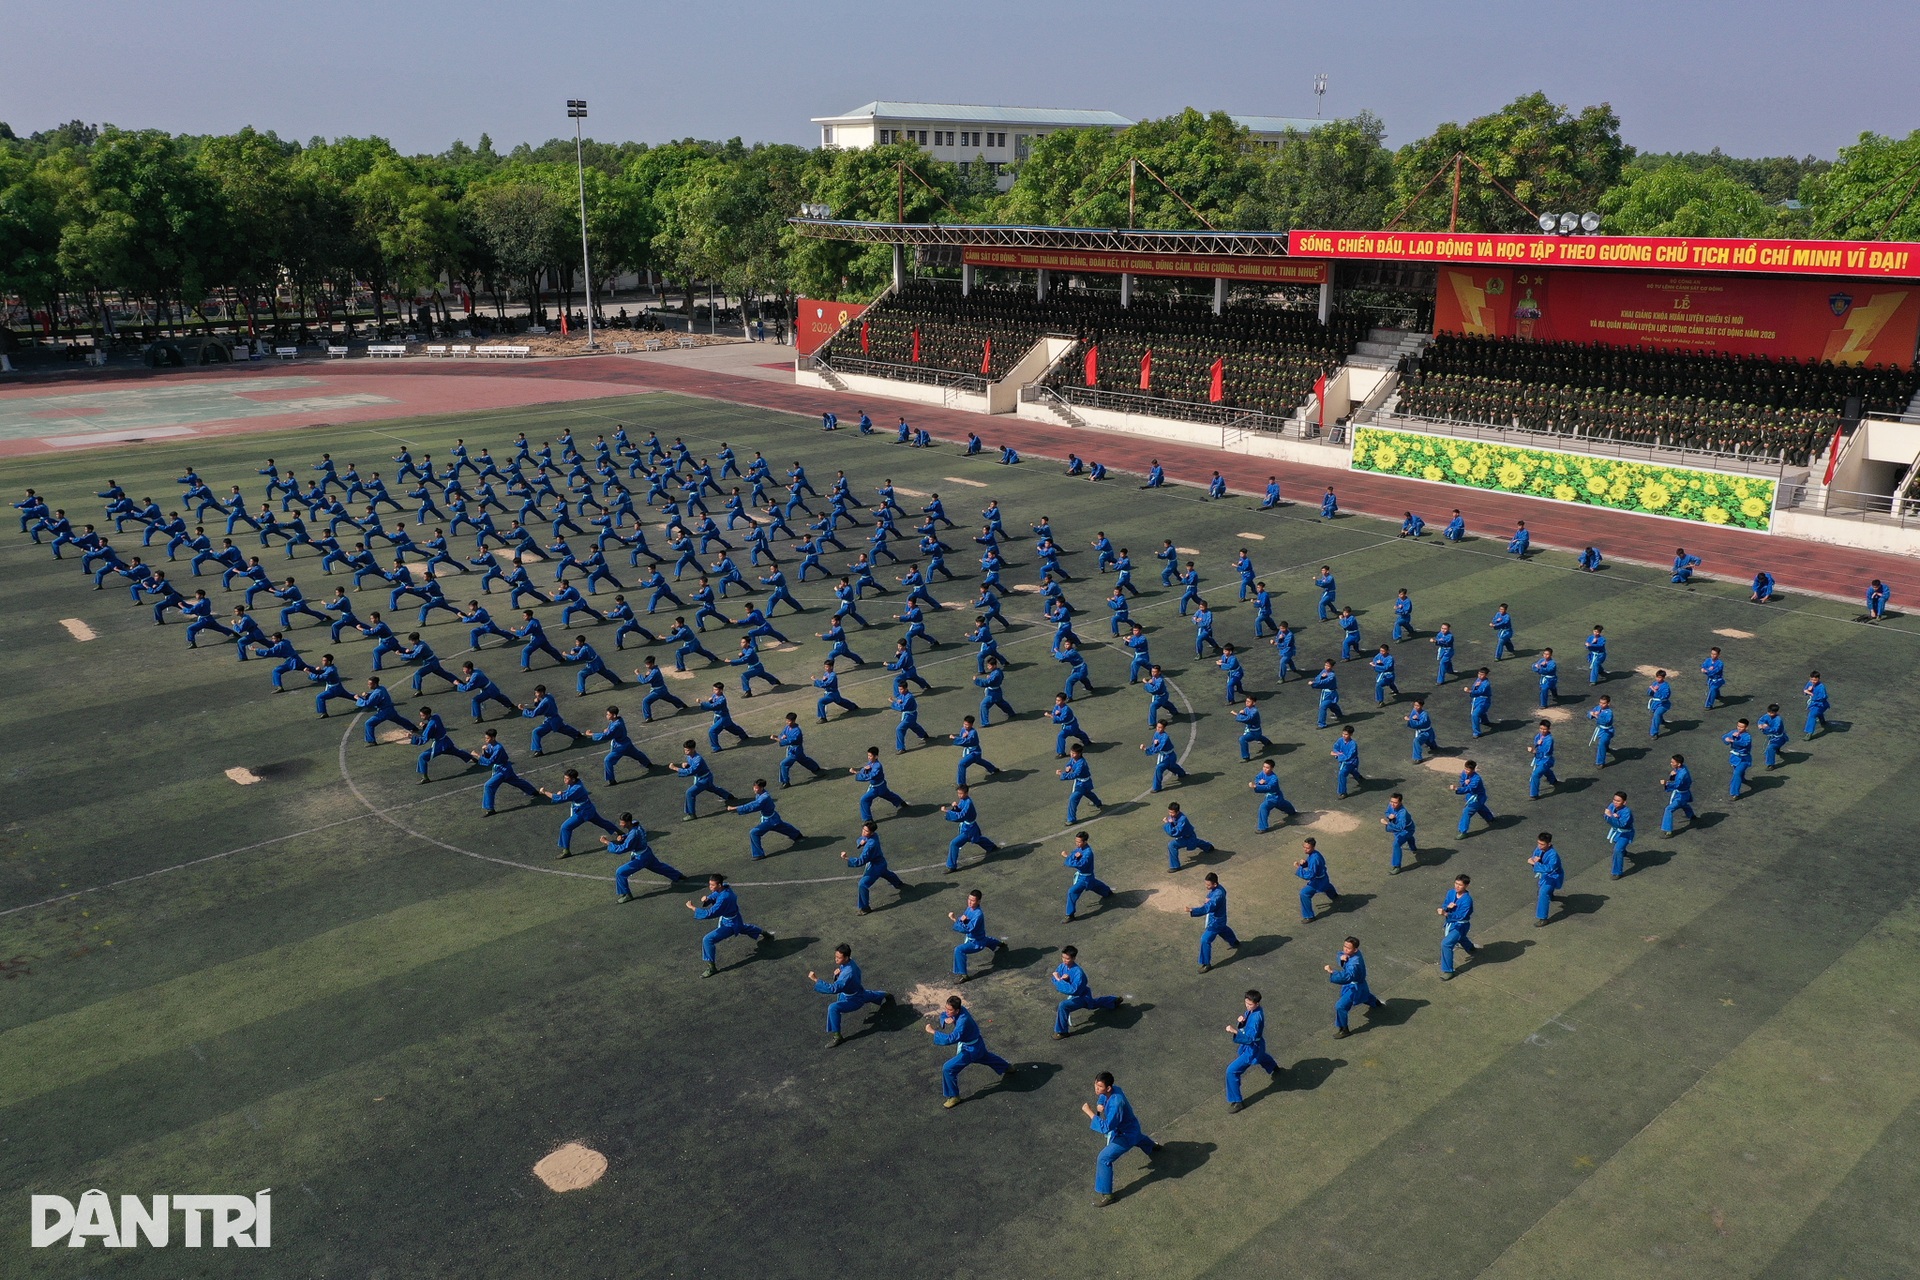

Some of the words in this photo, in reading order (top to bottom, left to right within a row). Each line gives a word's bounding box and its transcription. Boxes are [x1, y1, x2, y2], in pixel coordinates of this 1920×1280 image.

[1300, 234, 1334, 254] SỐNG,
[1338, 235, 1374, 253] CHIẾN
[1376, 236, 1405, 256] ĐẤU,
[1408, 240, 1434, 254] LAO
[1436, 238, 1473, 258] ĐỘNG
[1477, 240, 1492, 257] VÀ
[1496, 242, 1525, 260] HỌC
[1530, 241, 1555, 261] TẬP
[1559, 244, 1596, 260] THEO
[1600, 244, 1651, 261] GƯƠNG
[1655, 241, 1688, 262] CHỦ
[1693, 246, 1729, 266] TỊCH
[1733, 242, 1756, 264] HỒ
[1760, 246, 1791, 265] CHÍ
[1792, 249, 1842, 267] MINH
[1847, 248, 1867, 268] VĨ
[1869, 251, 1908, 272] ĐẠI!
[966, 250, 980, 260] CẢNH
[981, 251, 991, 260] SÁT
[1040, 254, 1058, 264] THÀNH
[1194, 261, 1210, 272] KIÊN
[1211, 262, 1236, 274] CƯỜNG,
[1238, 263, 1260, 274] CHÍNH
[1262, 266, 1277, 276] QUY,
[1280, 266, 1296, 276] TINH
[1674, 294, 1690, 309] LỄ
[1621, 310, 1634, 318] KHAI
[1705, 313, 1723, 323] CHIẾN
[812, 322, 832, 333] 2026
[1705, 326, 1717, 335] SÁT
[1744, 330, 1759, 338] NĂM
[1760, 331, 1776, 339] 2026
